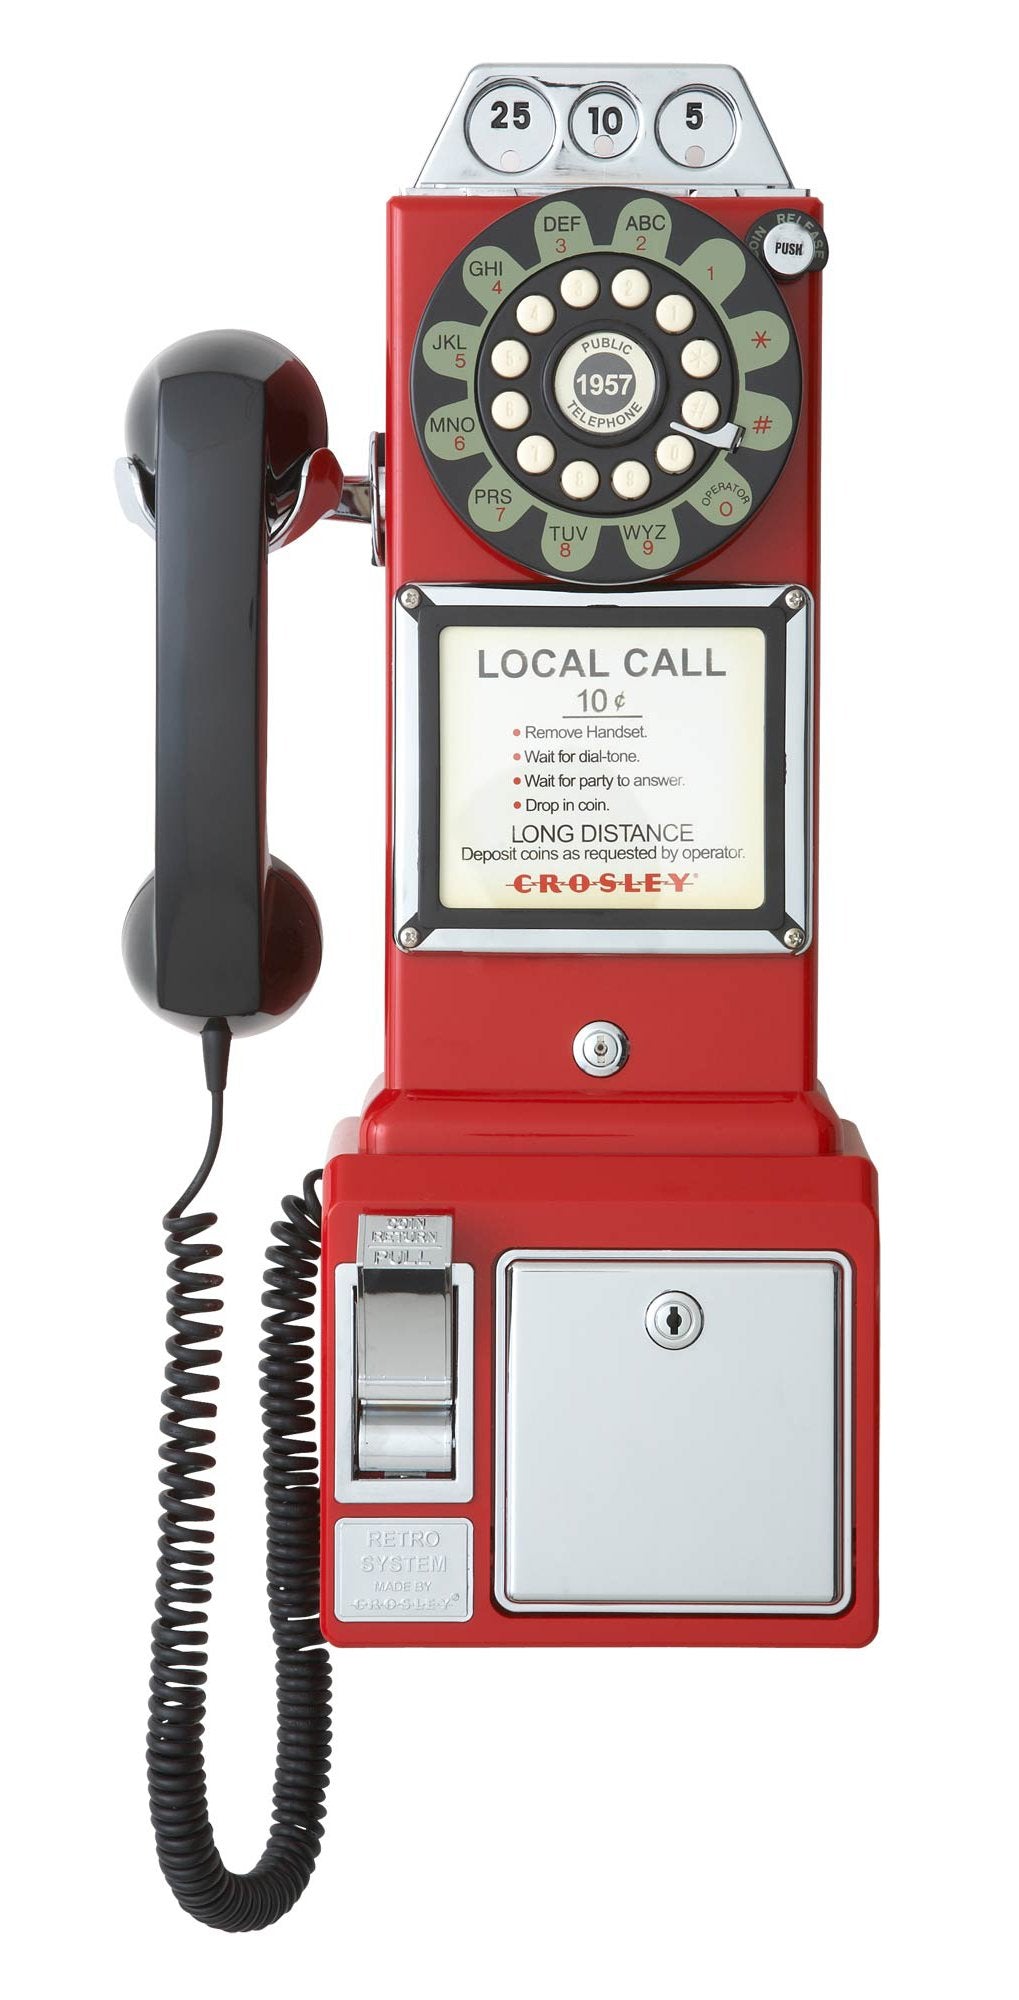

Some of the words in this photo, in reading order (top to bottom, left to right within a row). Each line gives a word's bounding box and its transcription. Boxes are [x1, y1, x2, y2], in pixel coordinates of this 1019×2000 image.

[490, 101, 531, 129] 25
[588, 106, 623, 135] 10
[686, 102, 704, 130] 5
[544, 216, 581, 232] DEF
[626, 215, 666, 231] ABC
[555, 238, 566, 253] 3
[636, 236, 647, 250] 2
[775, 242, 803, 256] PUSH
[469, 260, 503, 277] GHI
[707, 266, 714, 280] 1
[492, 280, 502, 294] 4
[432, 334, 467, 350] JKL
[581, 337, 633, 355] PUBLIC
[455, 354, 466, 368] 5
[576, 373, 633, 396] 1957
[567, 399, 643, 428] TELEPHONE
[430, 417, 475, 433] MNO
[454, 436, 465, 451] 6
[475, 489, 512, 504] PRS
[701, 482, 750, 507] OPERATOR
[496, 507, 506, 522] 7
[549, 526, 588, 542] TUV
[623, 524, 667, 540] WYZ
[560, 542, 571, 558] 8
[642, 540, 654, 555] 9
[478, 649, 609, 678] LOCAL
[624, 648, 727, 677] CALL
[577, 688, 608, 713] 10
[614, 691, 626, 711] ¢
[525, 726, 583, 739] Remove
[586, 725, 648, 739] Handset.
[524, 750, 555, 763] Wait
[558, 750, 576, 763] for
[578, 749, 640, 763] dial-tone.
[524, 774, 555, 787] Wait
[558, 774, 576, 787] for
[579, 774, 614, 790] party
[617, 775, 630, 787] to
[633, 775, 686, 787] answer.
[525, 798, 559, 814] Drop
[562, 798, 574, 811] in
[578, 798, 610, 811] coin.
[512, 824, 574, 843] LONG
[581, 823, 694, 842] DISTANCE
[461, 846, 518, 864] Deposit
[521, 846, 559, 861] coins
[563, 849, 580, 860] as
[584, 845, 657, 863] requested
[661, 845, 679, 863] by
[682, 846, 746, 862] operator.
[386, 1217, 427, 1230] COIN
[371, 1231, 438, 1244] RETURN
[374, 1250, 432, 1265] PULL
[368, 1530, 441, 1548] RETRO
[360, 1555, 447, 1573] SYSTEM
[374, 1581, 411, 1593] MADE
[415, 1581, 432, 1593] BY
